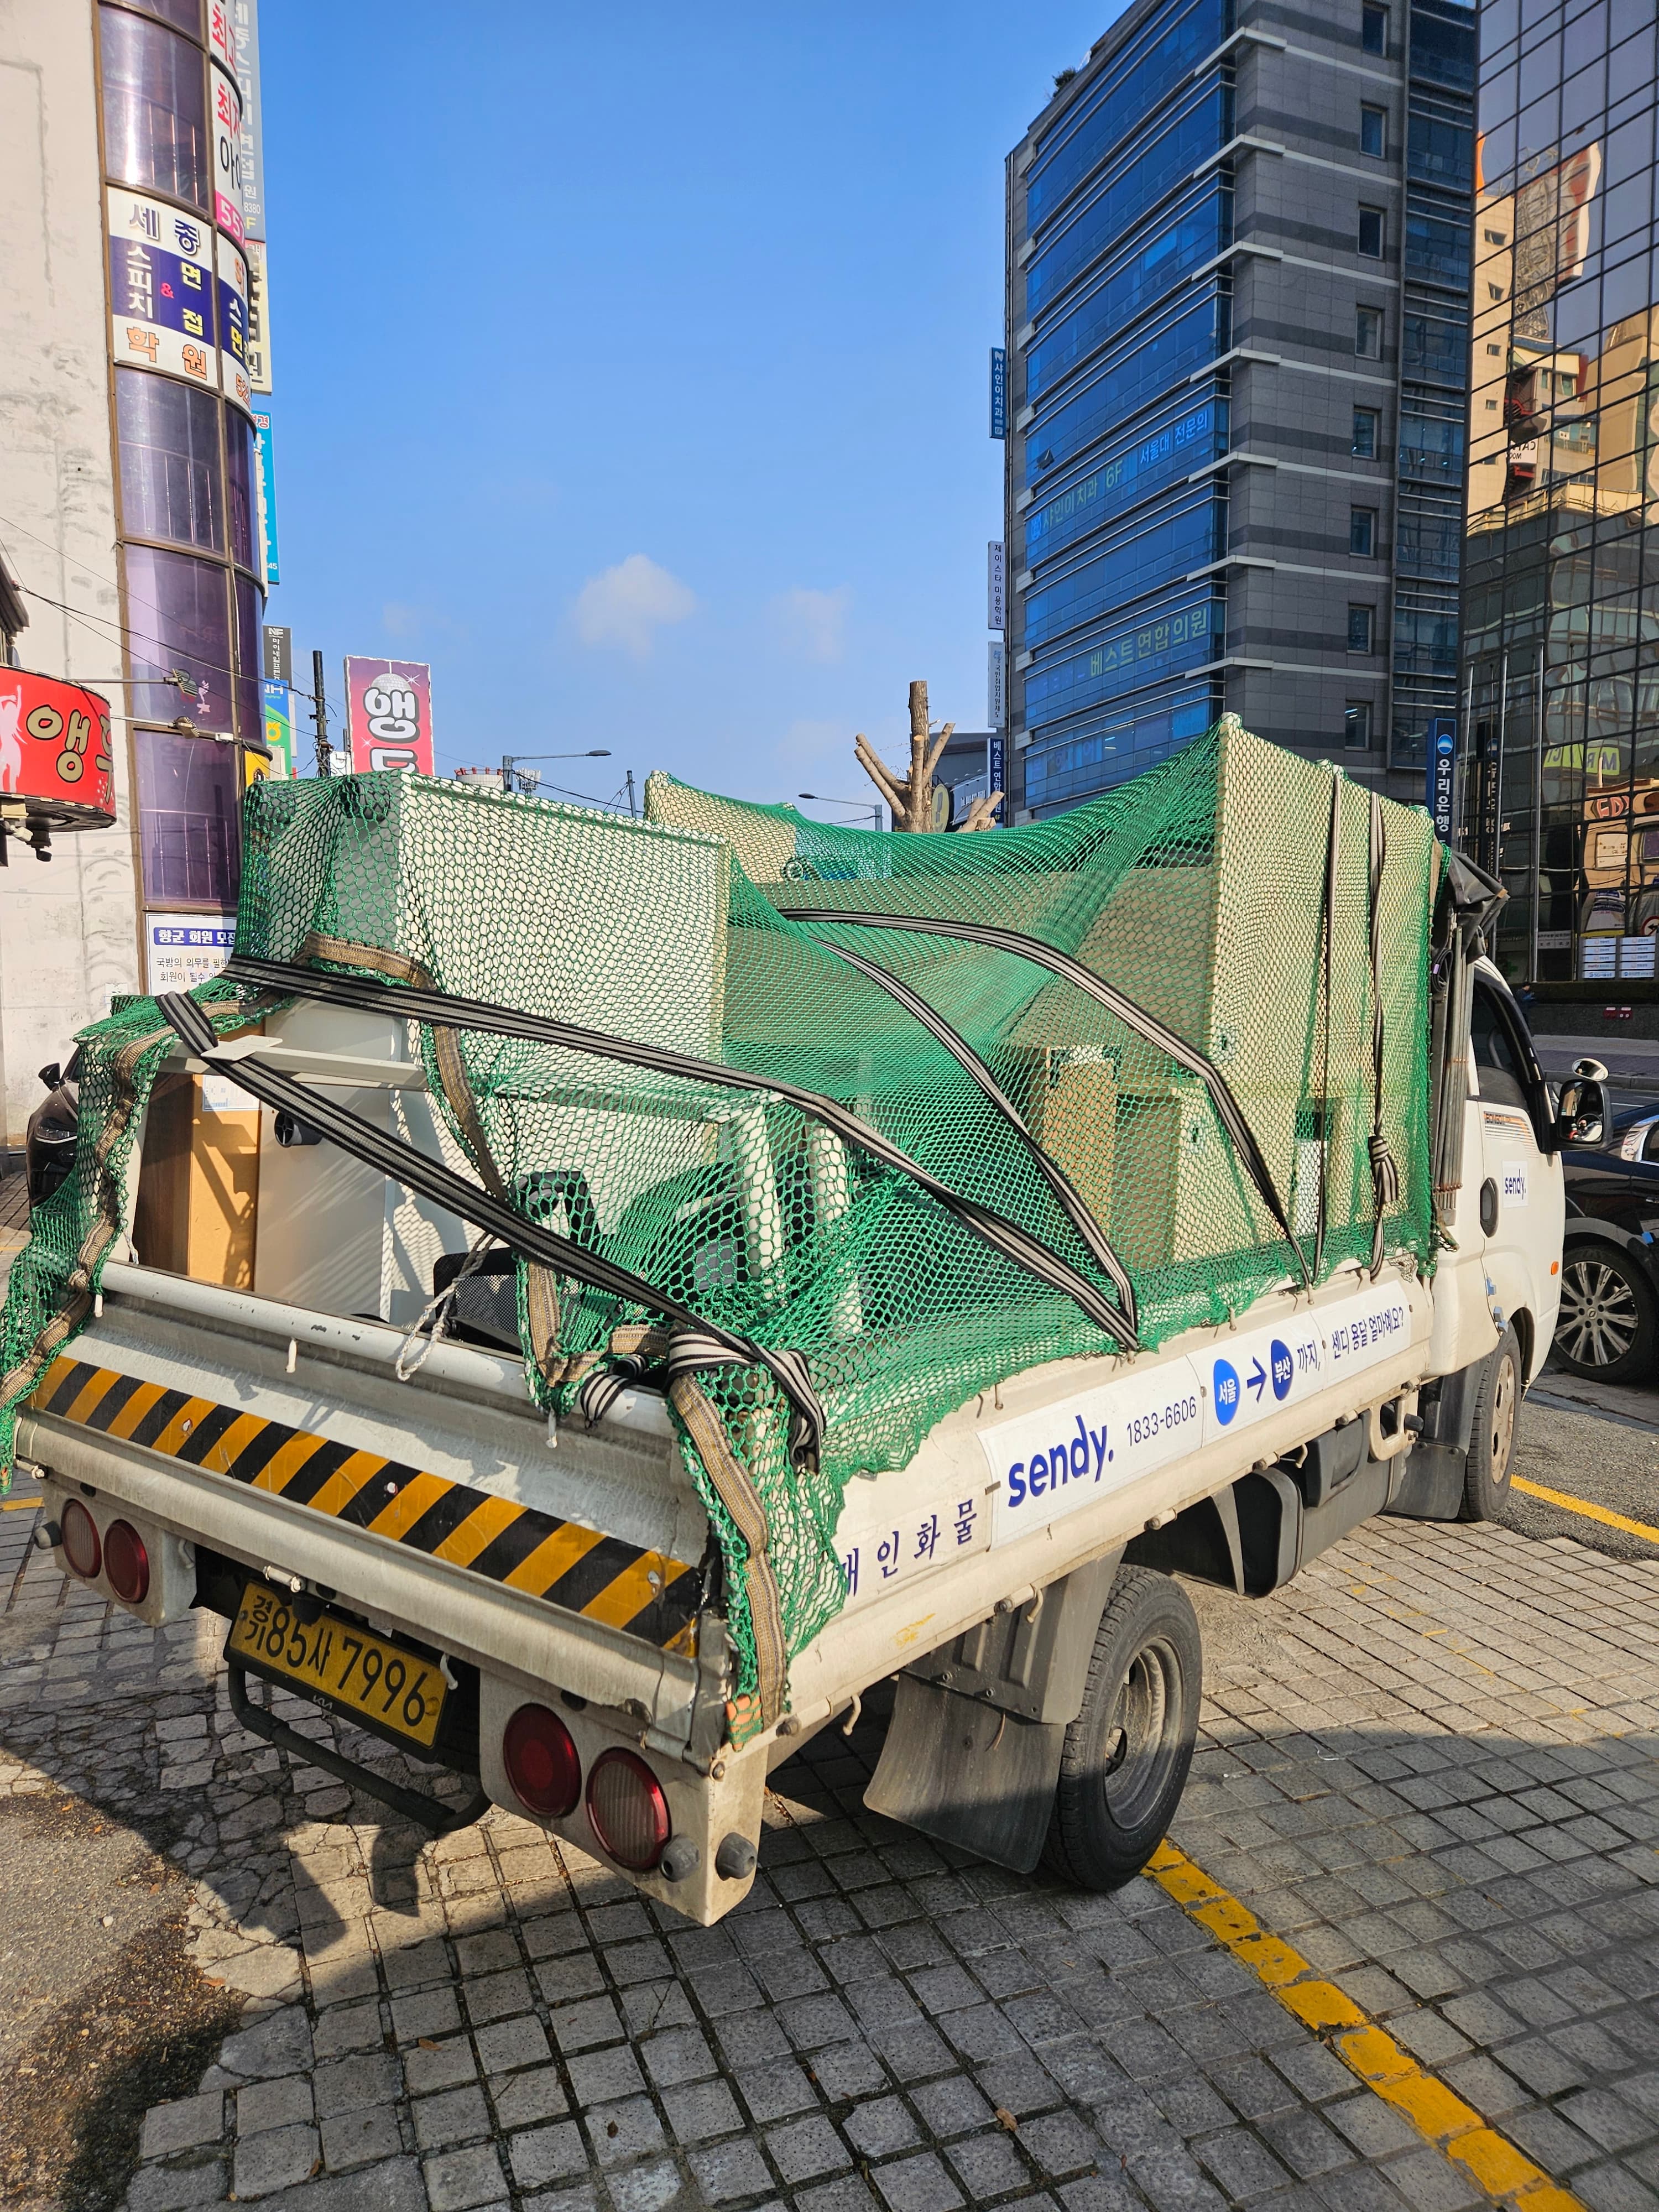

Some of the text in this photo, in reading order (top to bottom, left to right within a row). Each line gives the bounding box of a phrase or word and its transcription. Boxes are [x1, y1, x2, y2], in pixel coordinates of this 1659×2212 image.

[129, 204, 200, 256] 세종
[127, 246, 154, 320] 스피치
[180, 261, 204, 337] 면접
[127, 326, 207, 381] 학원
[994, 363, 1004, 419] 샤인이치과
[1140, 409, 1208, 465] 서울대 전문의
[1106, 460, 1123, 488] 6F
[993, 740, 1002, 769] 베스트
[1436, 758, 1451, 832] 우리은행
[156, 957, 182, 968] 국방의
[186, 957, 210, 968] 의무를
[158, 929, 185, 943] 향군
[189, 930, 213, 944] 회원
[160, 972, 185, 983] 회원이
[190, 972, 205, 983] 될수
[1504, 1168, 1526, 1201] sendy.
[1218, 1378, 1237, 1405] 서울
[1275, 1356, 1291, 1384] 부산
[1297, 1340, 1321, 1374] 까지,
[1332, 1327, 1349, 1360] 센디
[1350, 1319, 1368, 1351] 용달
[1008, 1396, 1197, 1508] sendy. 1833-6606
[244, 1594, 428, 1727] 경기 85사 7996
